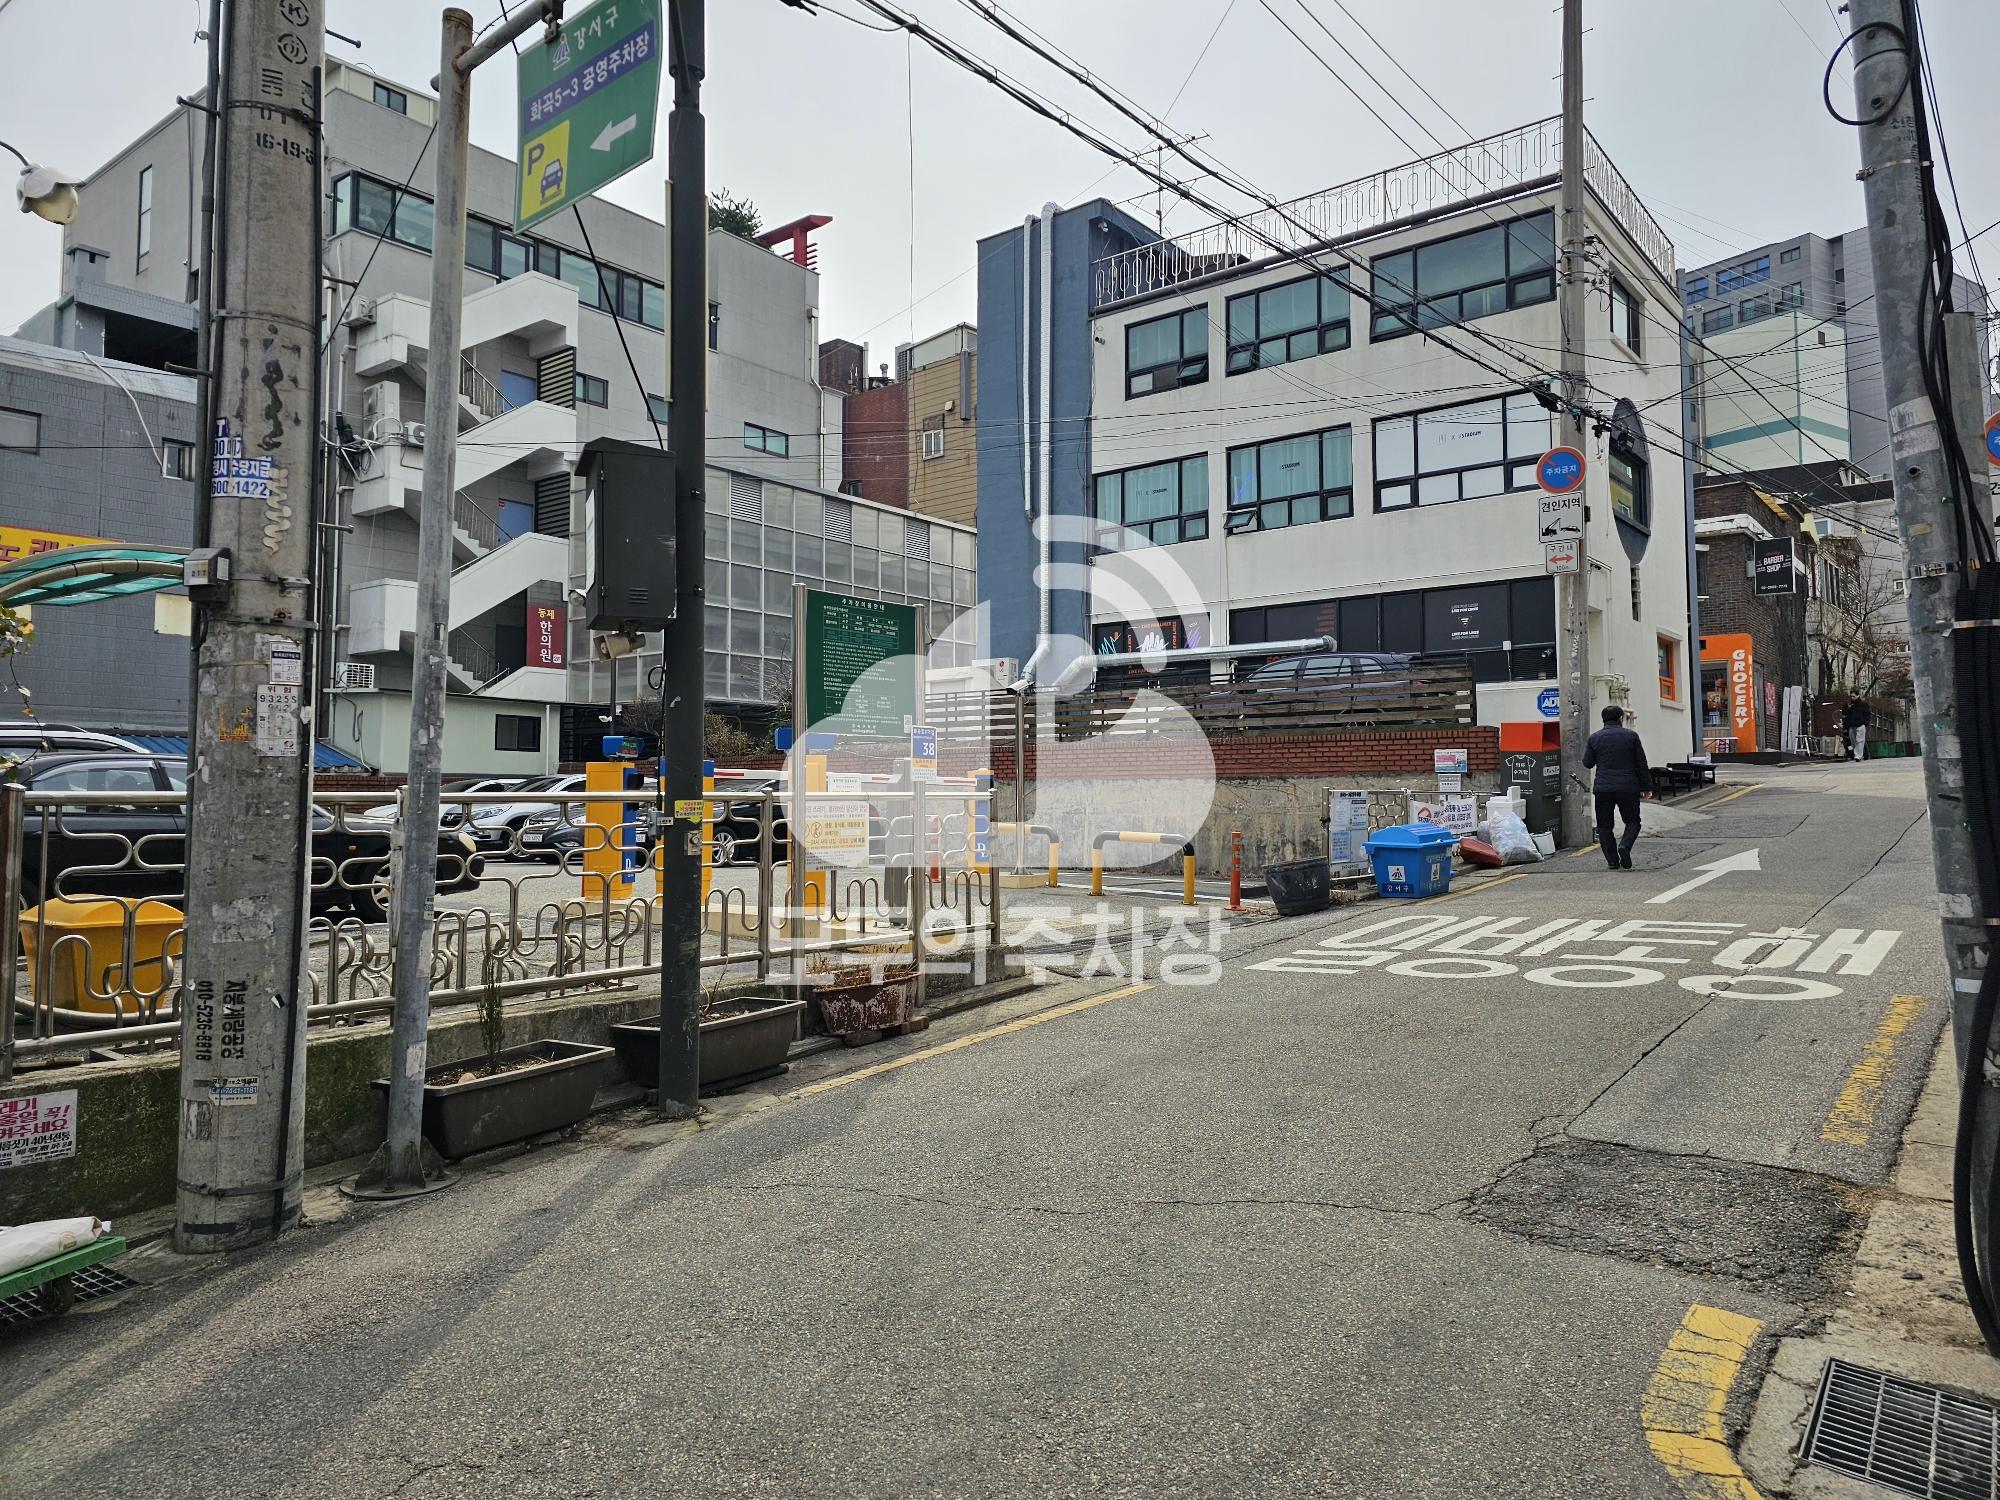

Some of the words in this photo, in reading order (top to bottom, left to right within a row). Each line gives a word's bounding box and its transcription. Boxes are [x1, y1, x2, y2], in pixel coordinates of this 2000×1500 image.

[574, 5, 619, 51] 강서구
[530, 78, 579, 122] 화곡5-3
[582, 31, 650, 91] 공영주차장
[527, 143, 545, 177] P
[1546, 464, 1577, 476] 주차금지
[1541, 497, 1581, 513] 견인지역
[1763, 555, 1784, 565] BARBER
[1767, 564, 1781, 573] SHOP
[540, 621, 553, 663] 한의원
[1732, 649, 1749, 729] GROCERY
[922, 742, 935, 756] 38
